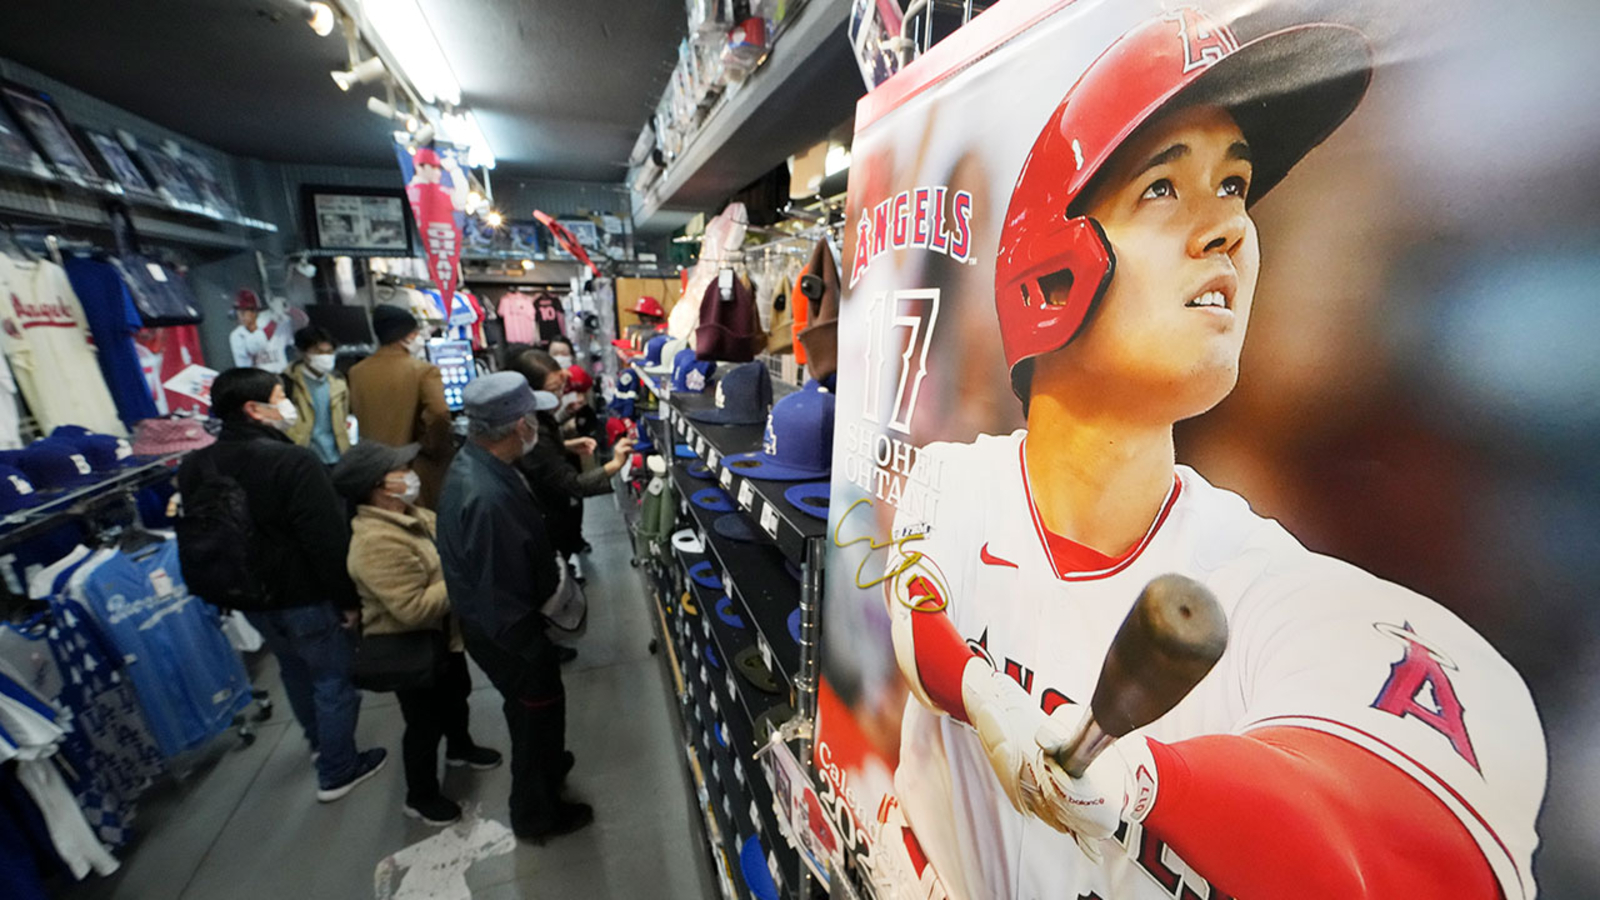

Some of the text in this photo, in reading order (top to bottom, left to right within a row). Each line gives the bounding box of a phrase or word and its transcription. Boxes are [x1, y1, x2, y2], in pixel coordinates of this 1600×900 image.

[850, 186, 973, 290] ANGELS
[863, 288, 941, 435] 17
[845, 455, 940, 530] OHTANI
[848, 424, 944, 493] SHOHEI
